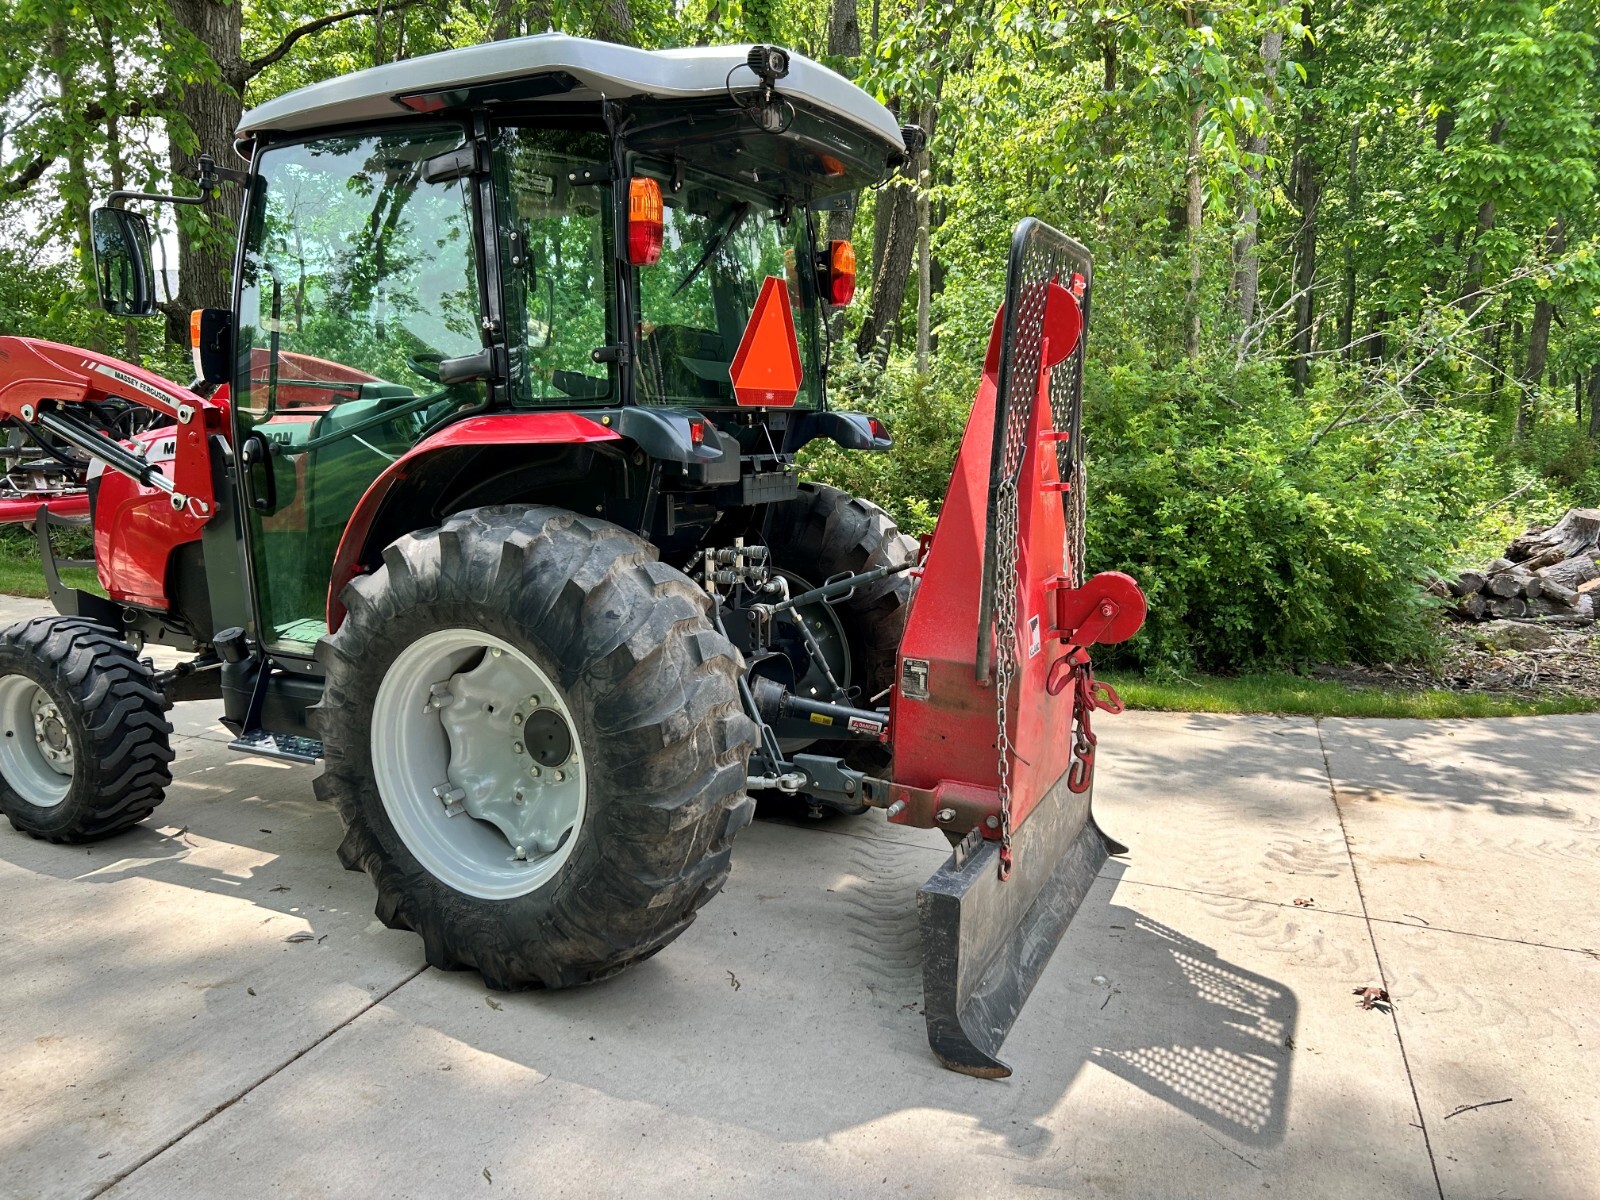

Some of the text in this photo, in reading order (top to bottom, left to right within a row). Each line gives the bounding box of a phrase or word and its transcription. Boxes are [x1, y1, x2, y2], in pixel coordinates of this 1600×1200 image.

[114, 371, 171, 404] MASSEY FERGUSON
[163, 441, 176, 455] M
[859, 722, 878, 731] DANGER
